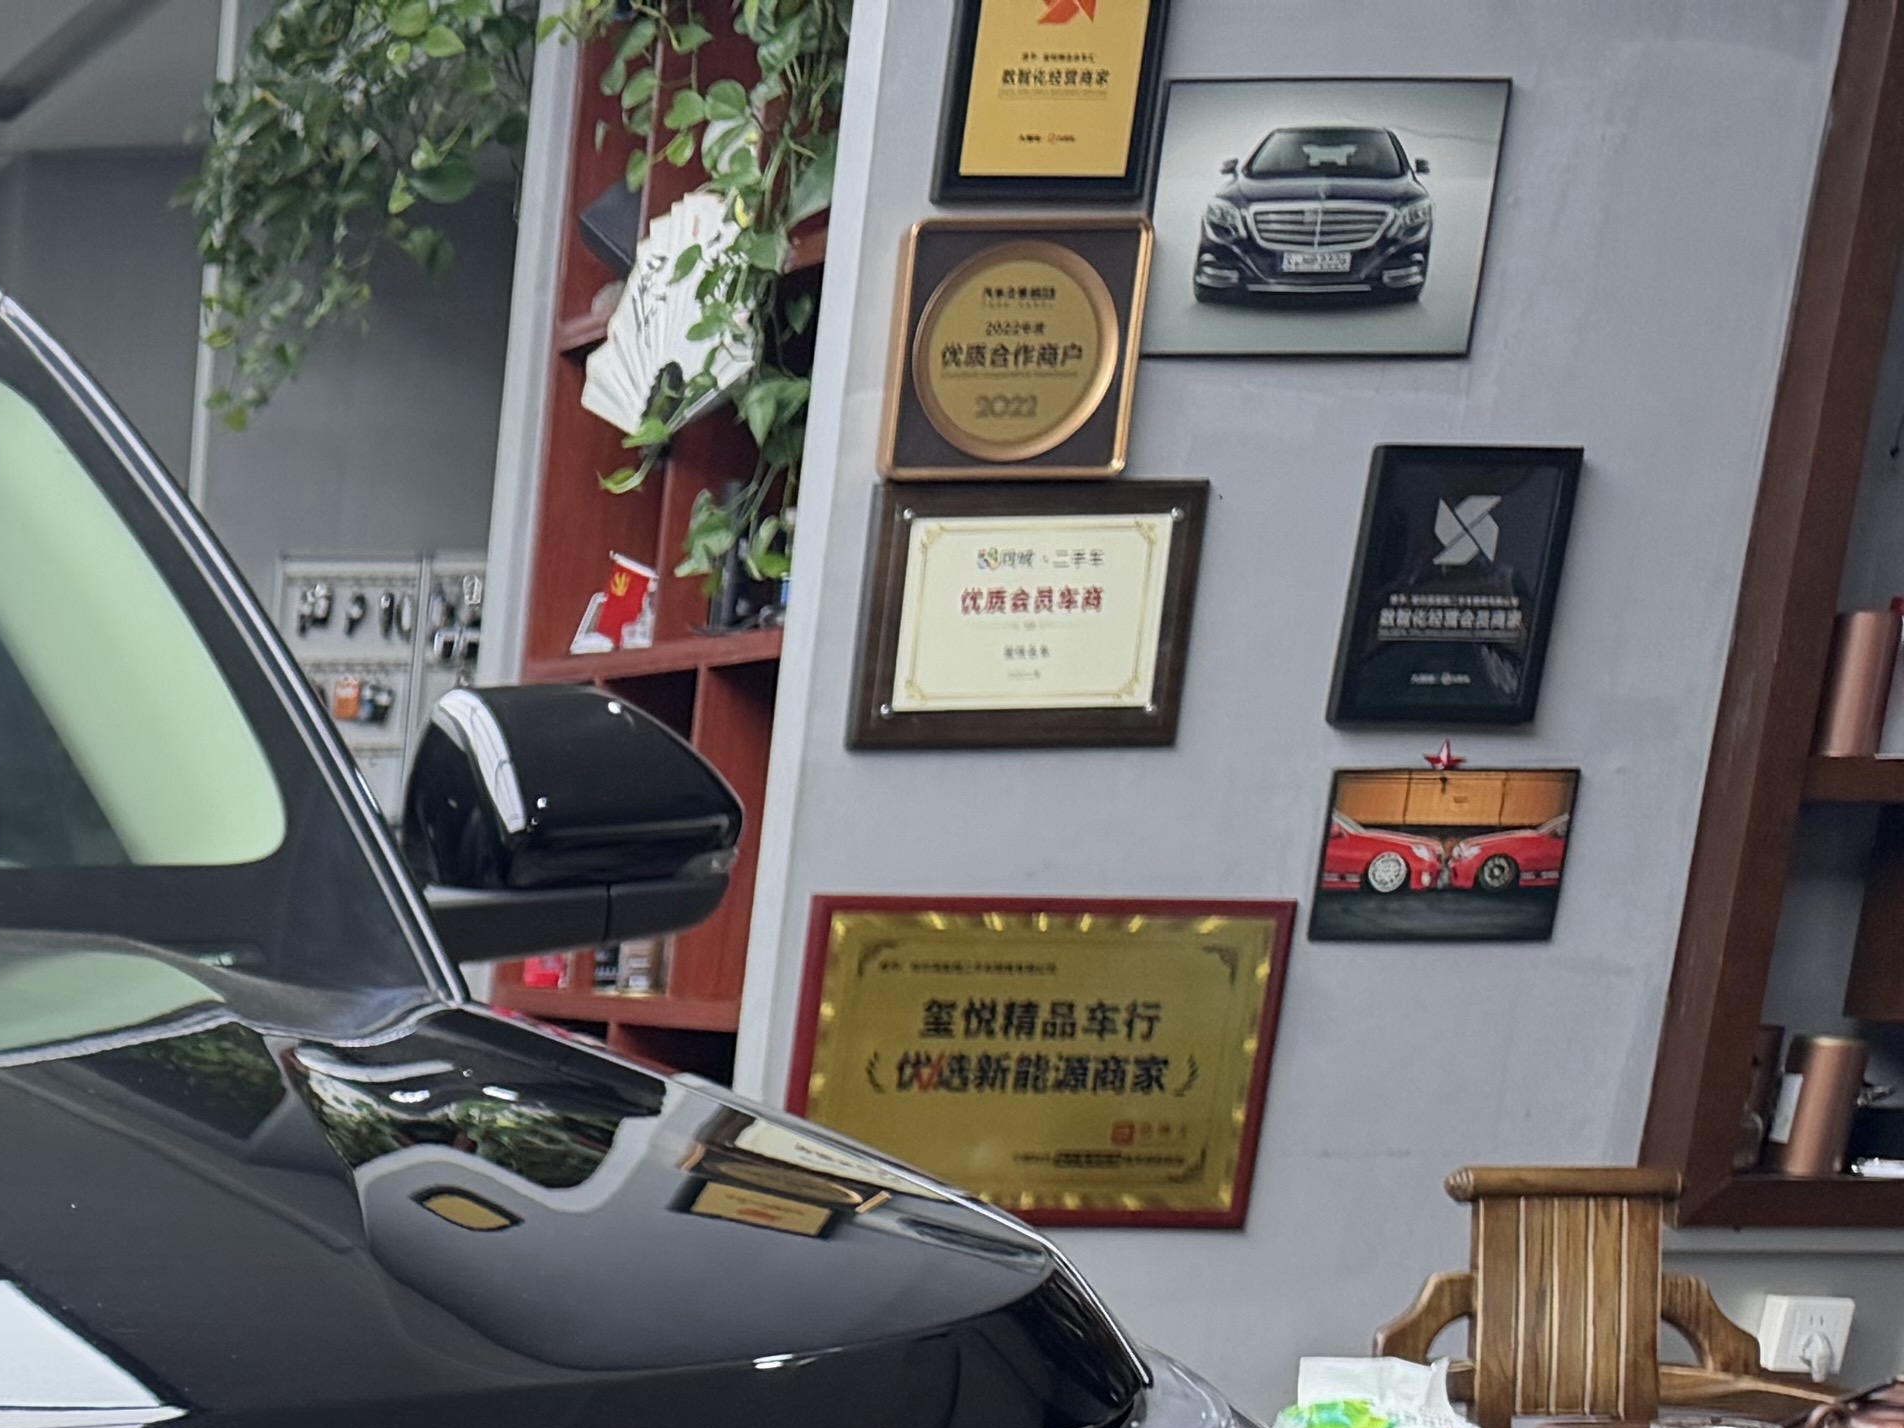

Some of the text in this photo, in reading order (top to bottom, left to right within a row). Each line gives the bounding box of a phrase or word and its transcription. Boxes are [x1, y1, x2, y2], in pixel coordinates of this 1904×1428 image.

[942, 341, 1083, 368] 优质合作商户
[960, 585, 1104, 615] 优质会员车商
[919, 997, 1162, 1041] 玺悦精品车行
